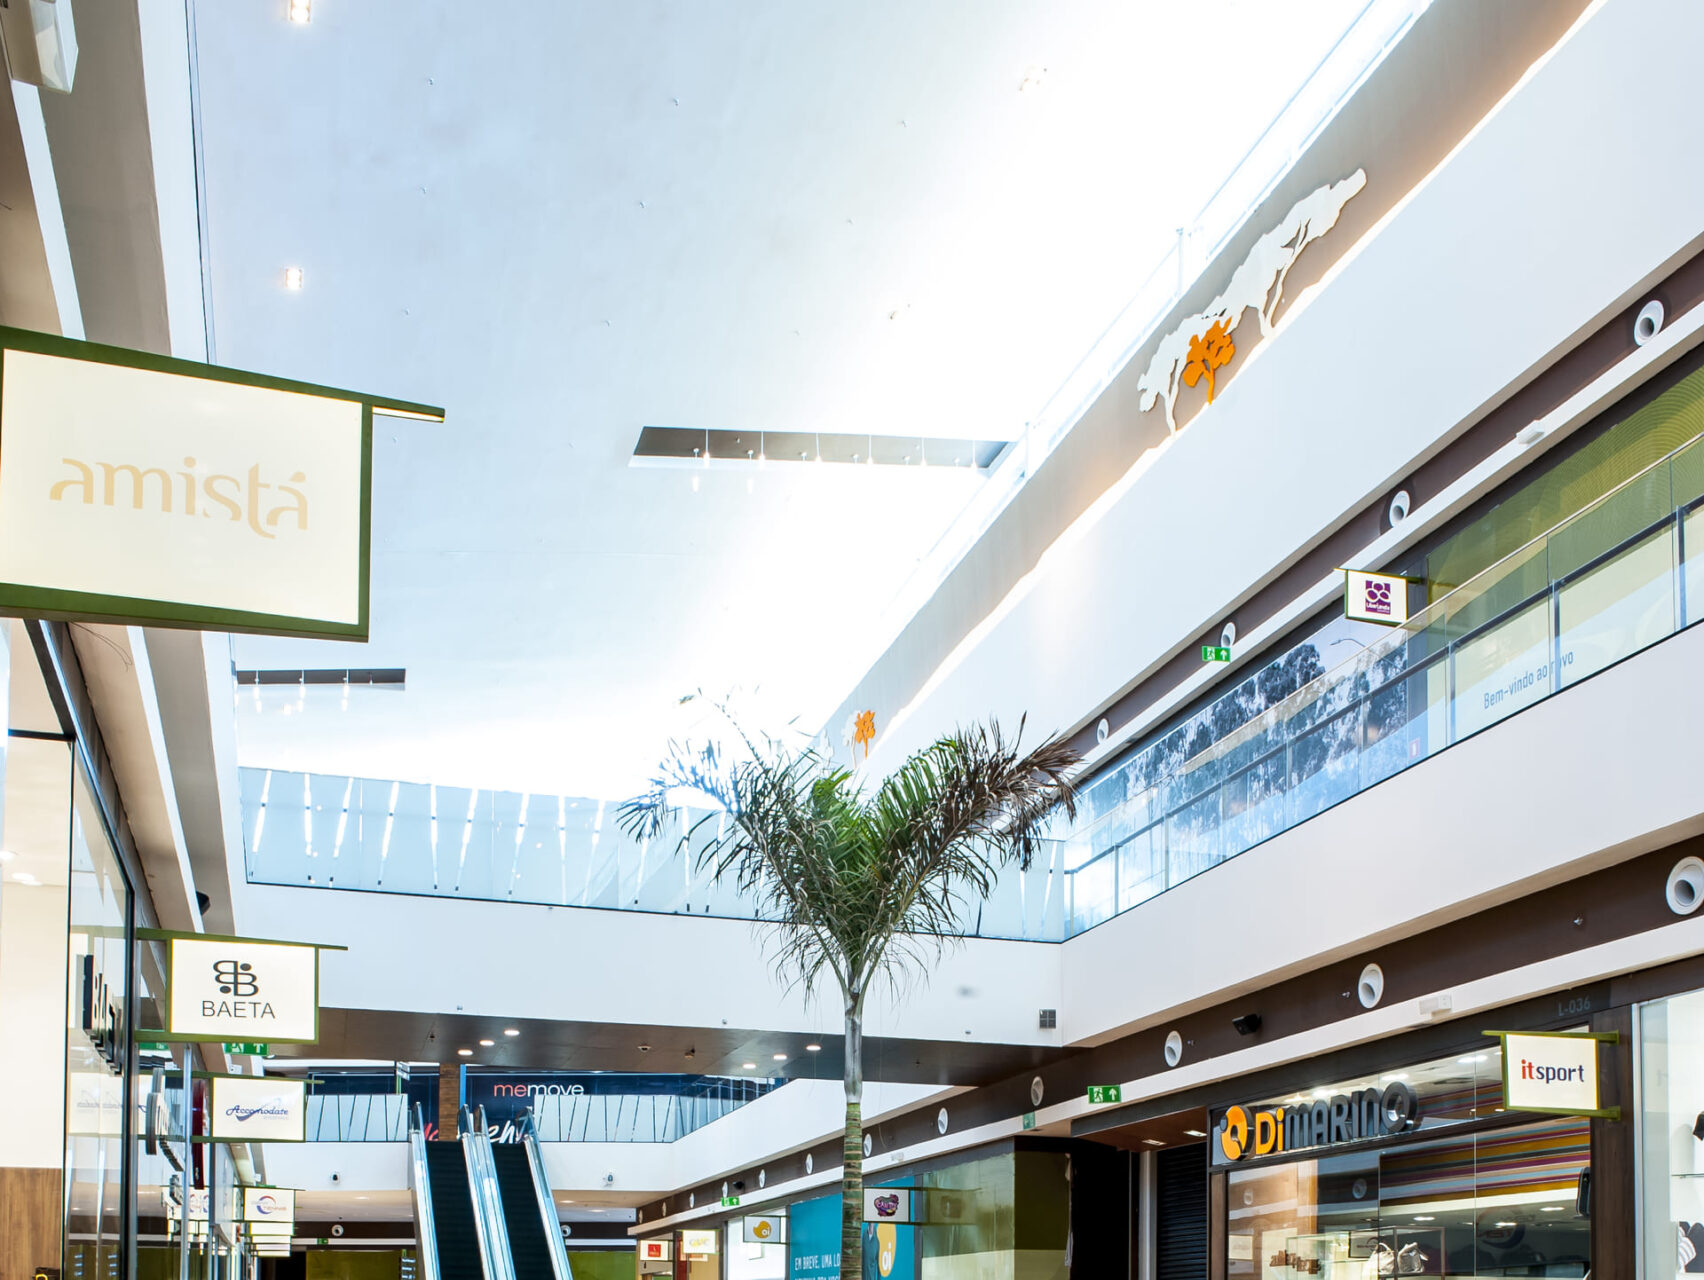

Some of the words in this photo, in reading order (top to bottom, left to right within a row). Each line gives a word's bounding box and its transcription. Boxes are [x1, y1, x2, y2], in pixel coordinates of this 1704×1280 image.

[1484, 670, 1534, 709] Bem-vindo
[1537, 665, 1548, 680] ao
[1550, 651, 1573, 675] nvo
[202, 1000, 276, 1018] BAETA
[1558, 995, 1590, 1016] L-036
[494, 1084, 584, 1097] memove
[795, 1257, 802, 1270] EM
[821, 1253, 833, 1268] UMA
[833, 1252, 841, 1267] LO
[881, 1241, 892, 1271] oi
